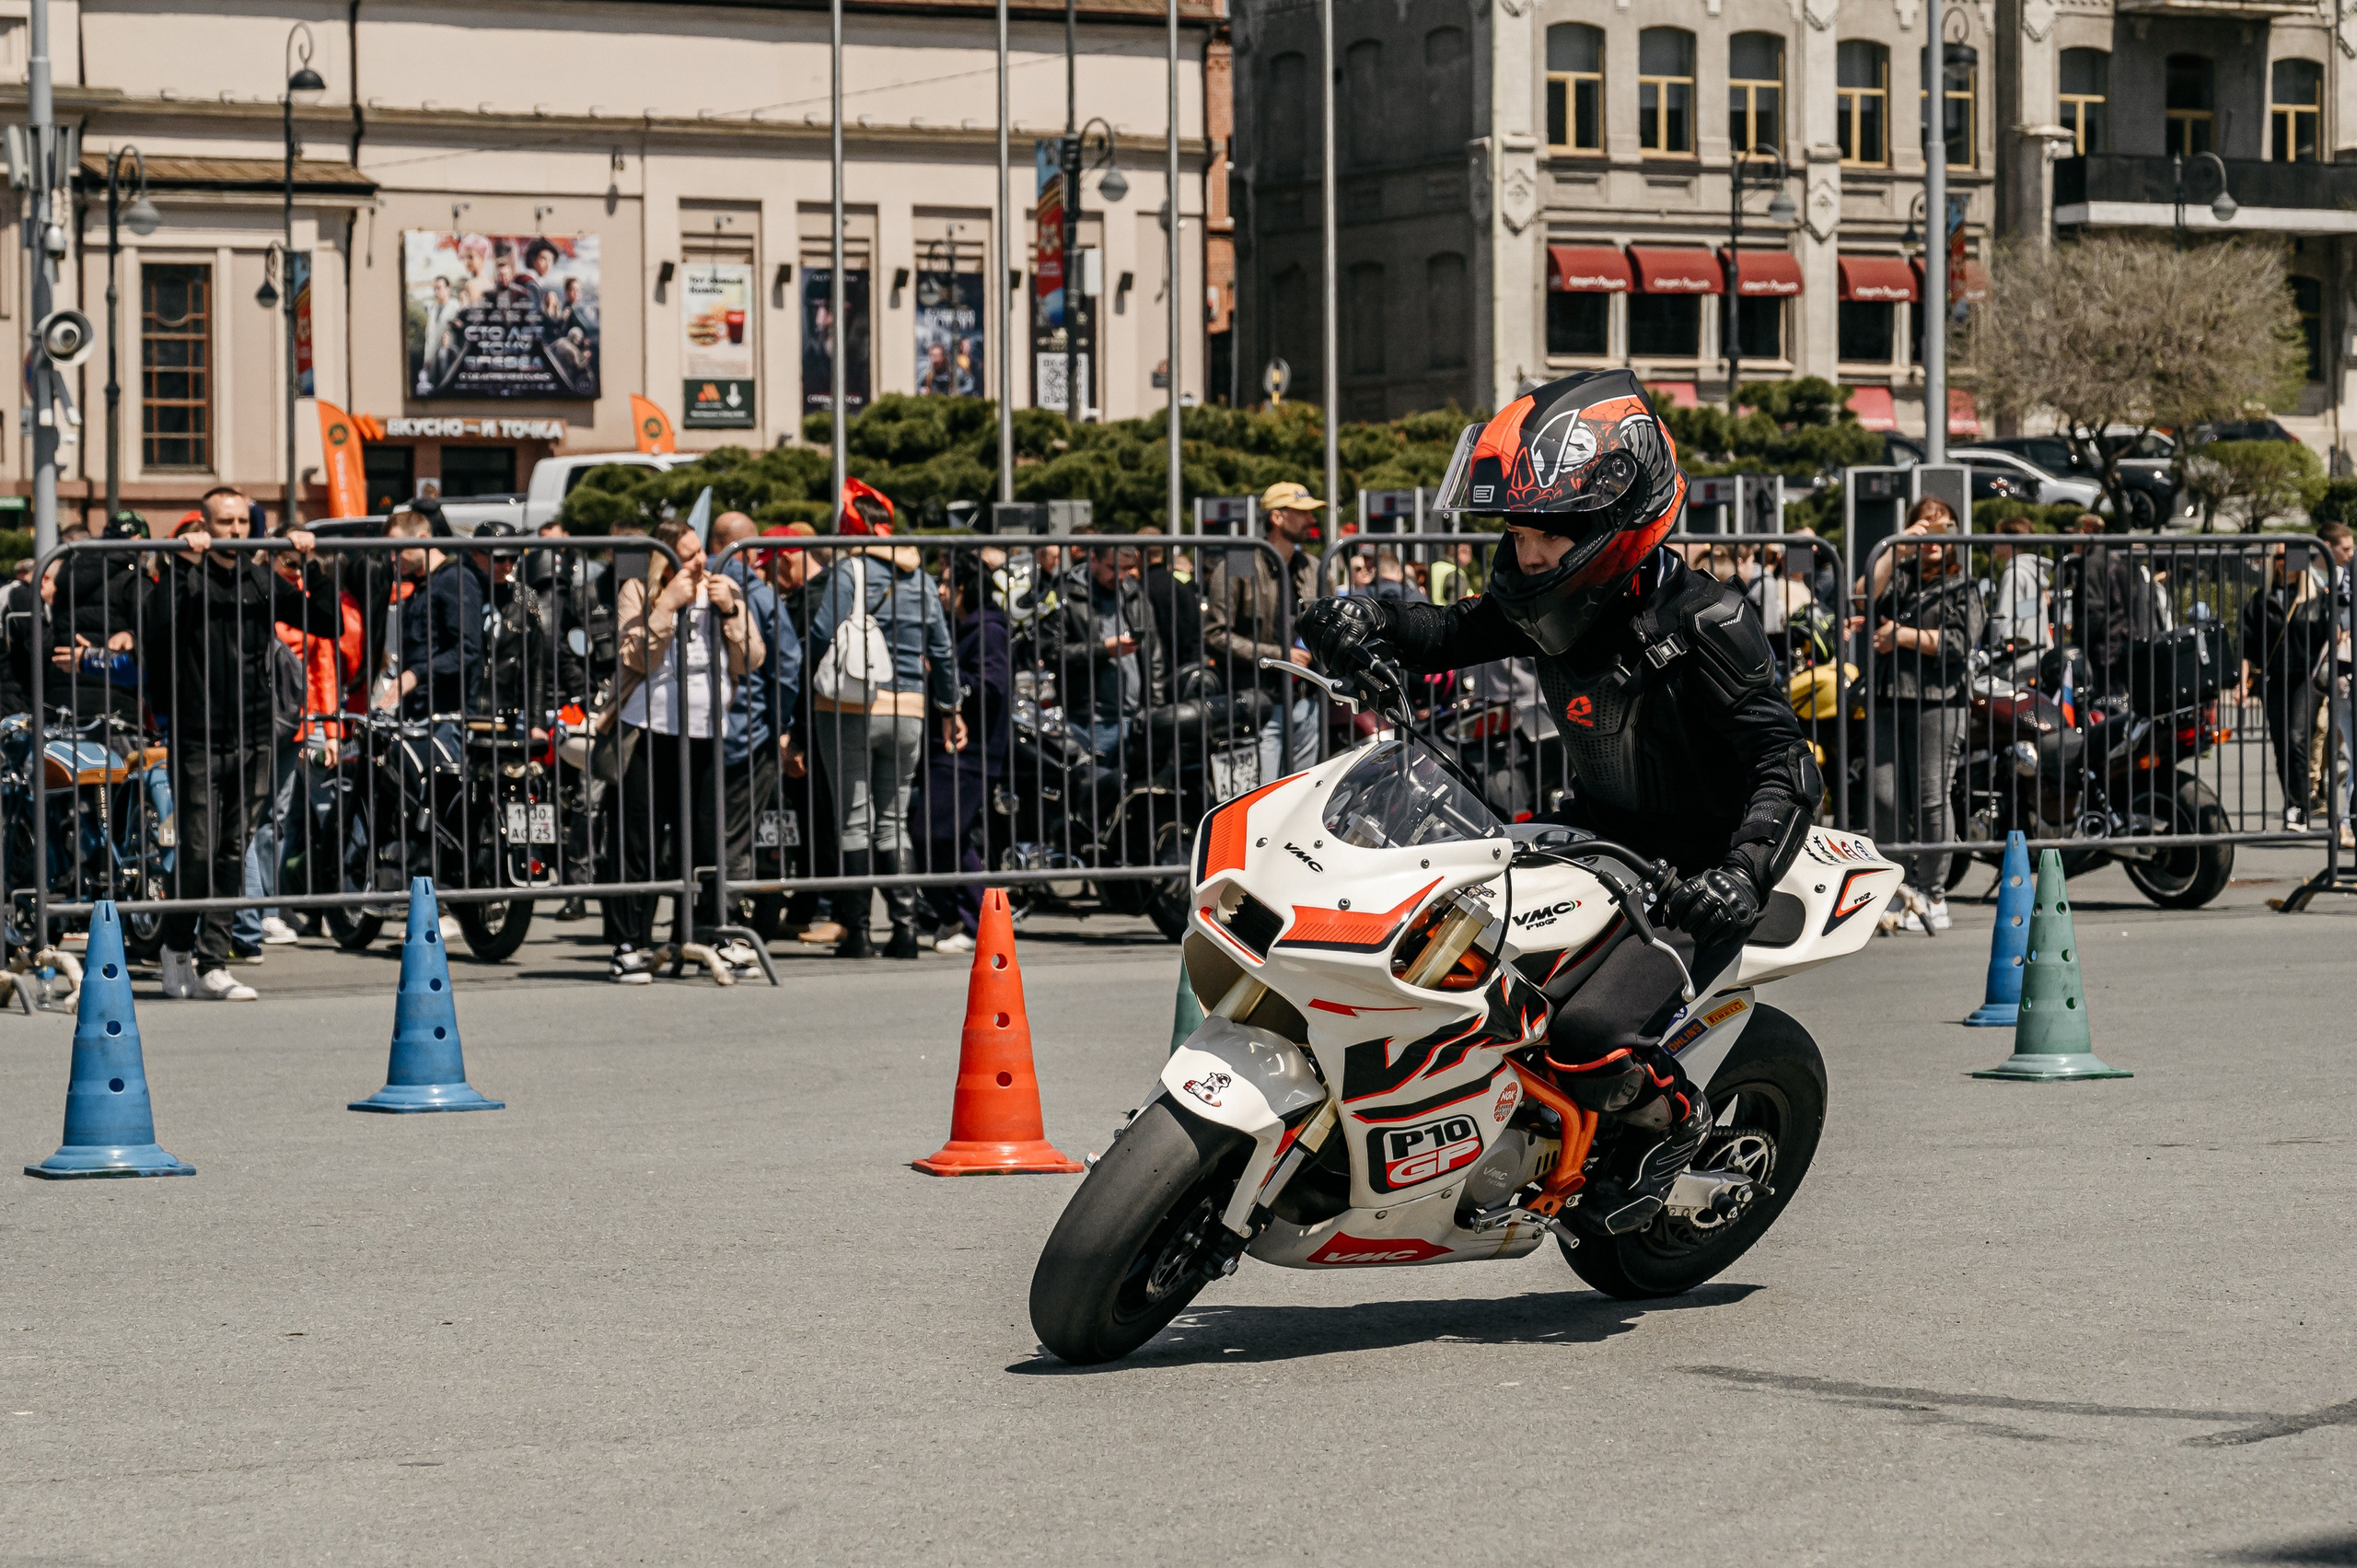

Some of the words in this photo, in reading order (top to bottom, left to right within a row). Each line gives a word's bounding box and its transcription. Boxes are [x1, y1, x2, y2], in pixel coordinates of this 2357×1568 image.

[387, 418, 464, 437] ВКУСНО
[499, 420, 563, 439] ТОЧКА
[1283, 842, 1323, 873] VMC
[1512, 901, 1573, 926] VMC
[1707, 1001, 1743, 1025] PIRELLI
[1500, 1089, 1516, 1102] NGK
[1389, 1119, 1471, 1160] P10
[1389, 1140, 1480, 1184] GP
[1323, 1249, 1418, 1262] VMC
